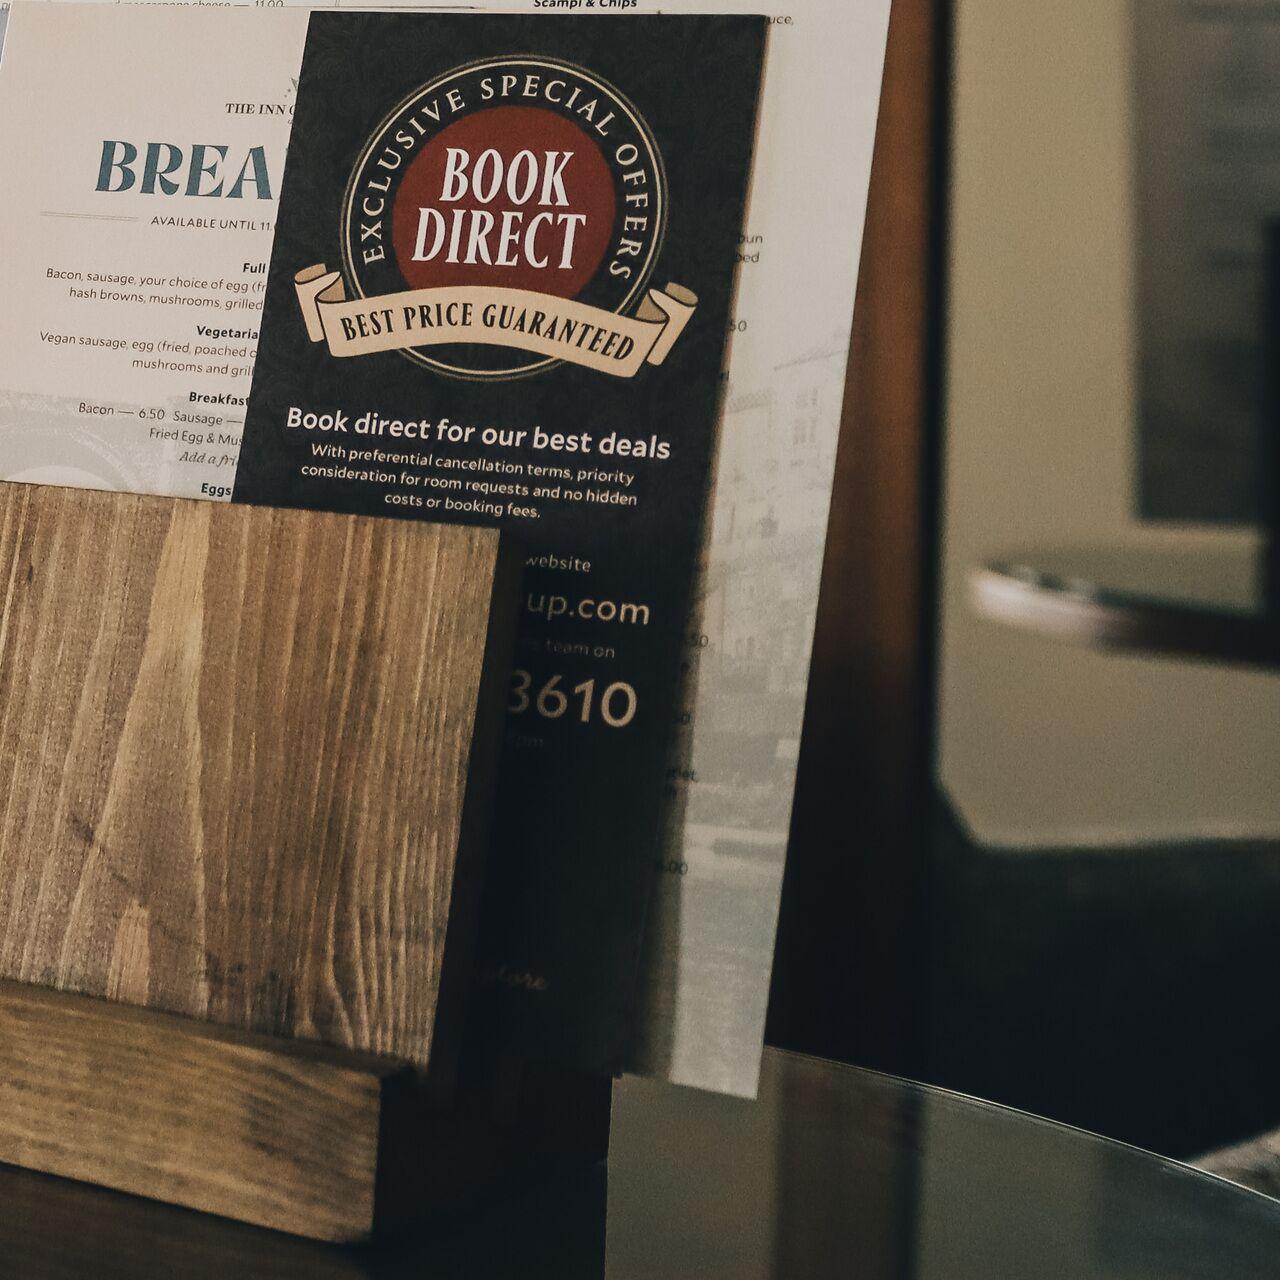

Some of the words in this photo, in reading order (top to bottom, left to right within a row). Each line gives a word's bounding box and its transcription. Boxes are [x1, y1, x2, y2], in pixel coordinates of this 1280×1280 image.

[225, 103, 255, 114] THE
[258, 104, 286, 115] INN
[95, 140, 274, 200] BREA
[362, 87, 466, 265] EXCLUSIVE
[480, 75, 616, 137] SPECIAL
[608, 142, 649, 281] OFFERS
[439, 147, 576, 207] BOOK
[151, 216, 216, 229] AVAILABLE
[219, 219, 256, 231] UNTIL
[260, 221, 274, 231] 11.
[411, 207, 587, 270] DIRECT
[46, 267, 83, 282] Bacon,
[86, 272, 137, 286] sausage,
[139, 275, 166, 287] your
[169, 277, 208, 289] choice
[210, 278, 224, 290] of
[226, 281, 249, 294] egg
[251, 280, 267, 293] (fr
[242, 262, 266, 274] Full
[69, 286, 97, 299] hash
[100, 288, 146, 304] browns,
[149, 294, 222, 309] mushrooms,
[225, 297, 263, 311] grilled
[40, 331, 76, 345] Vegan
[79, 336, 128, 350] sausage,
[132, 341, 154, 353] egg
[194, 344, 247, 359] poached
[196, 325, 259, 340] Vegetaria
[340, 309, 394, 342] BEST
[403, 301, 473, 331] PRICE
[482, 303, 635, 362] GUARANTEED
[132, 358, 203, 373] mushrooms
[205, 362, 228, 375] and
[78, 402, 114, 416] Bacon
[138, 407, 165, 420] 6.50
[172, 410, 223, 427] Sausage
[149, 427, 179, 442] Fried
[181, 430, 203, 445] Egg
[206, 433, 215, 444] &
[218, 433, 243, 446] Mus
[286, 406, 349, 434] Book
[354, 413, 430, 441] direct
[436, 417, 476, 444] for
[481, 425, 526, 448] our
[533, 426, 591, 454] best
[598, 430, 671, 460] deals
[179, 451, 205, 464] Add
[207, 455, 216, 465] a
[216, 453, 237, 468] fri
[311, 443, 346, 460] With
[349, 446, 433, 467] preferential
[435, 454, 523, 476] cancellation
[527, 463, 573, 481] terms,
[577, 467, 635, 488] priority
[201, 482, 232, 497] Eggs
[301, 464, 396, 484] consideration
[400, 470, 421, 486] for
[424, 475, 462, 490] room
[466, 478, 529, 497] requests
[533, 482, 560, 499] and
[564, 487, 582, 501] no
[585, 488, 637, 506] hidden
[385, 492, 422, 508] costs
[426, 495, 441, 508] or
[445, 496, 503, 518] booking
[507, 502, 541, 519] fees.
[526, 554, 592, 574] website
[527, 592, 651, 625] up.com
[545, 637, 590, 658] team
[593, 645, 616, 660] on
[506, 669, 638, 728] 3610
